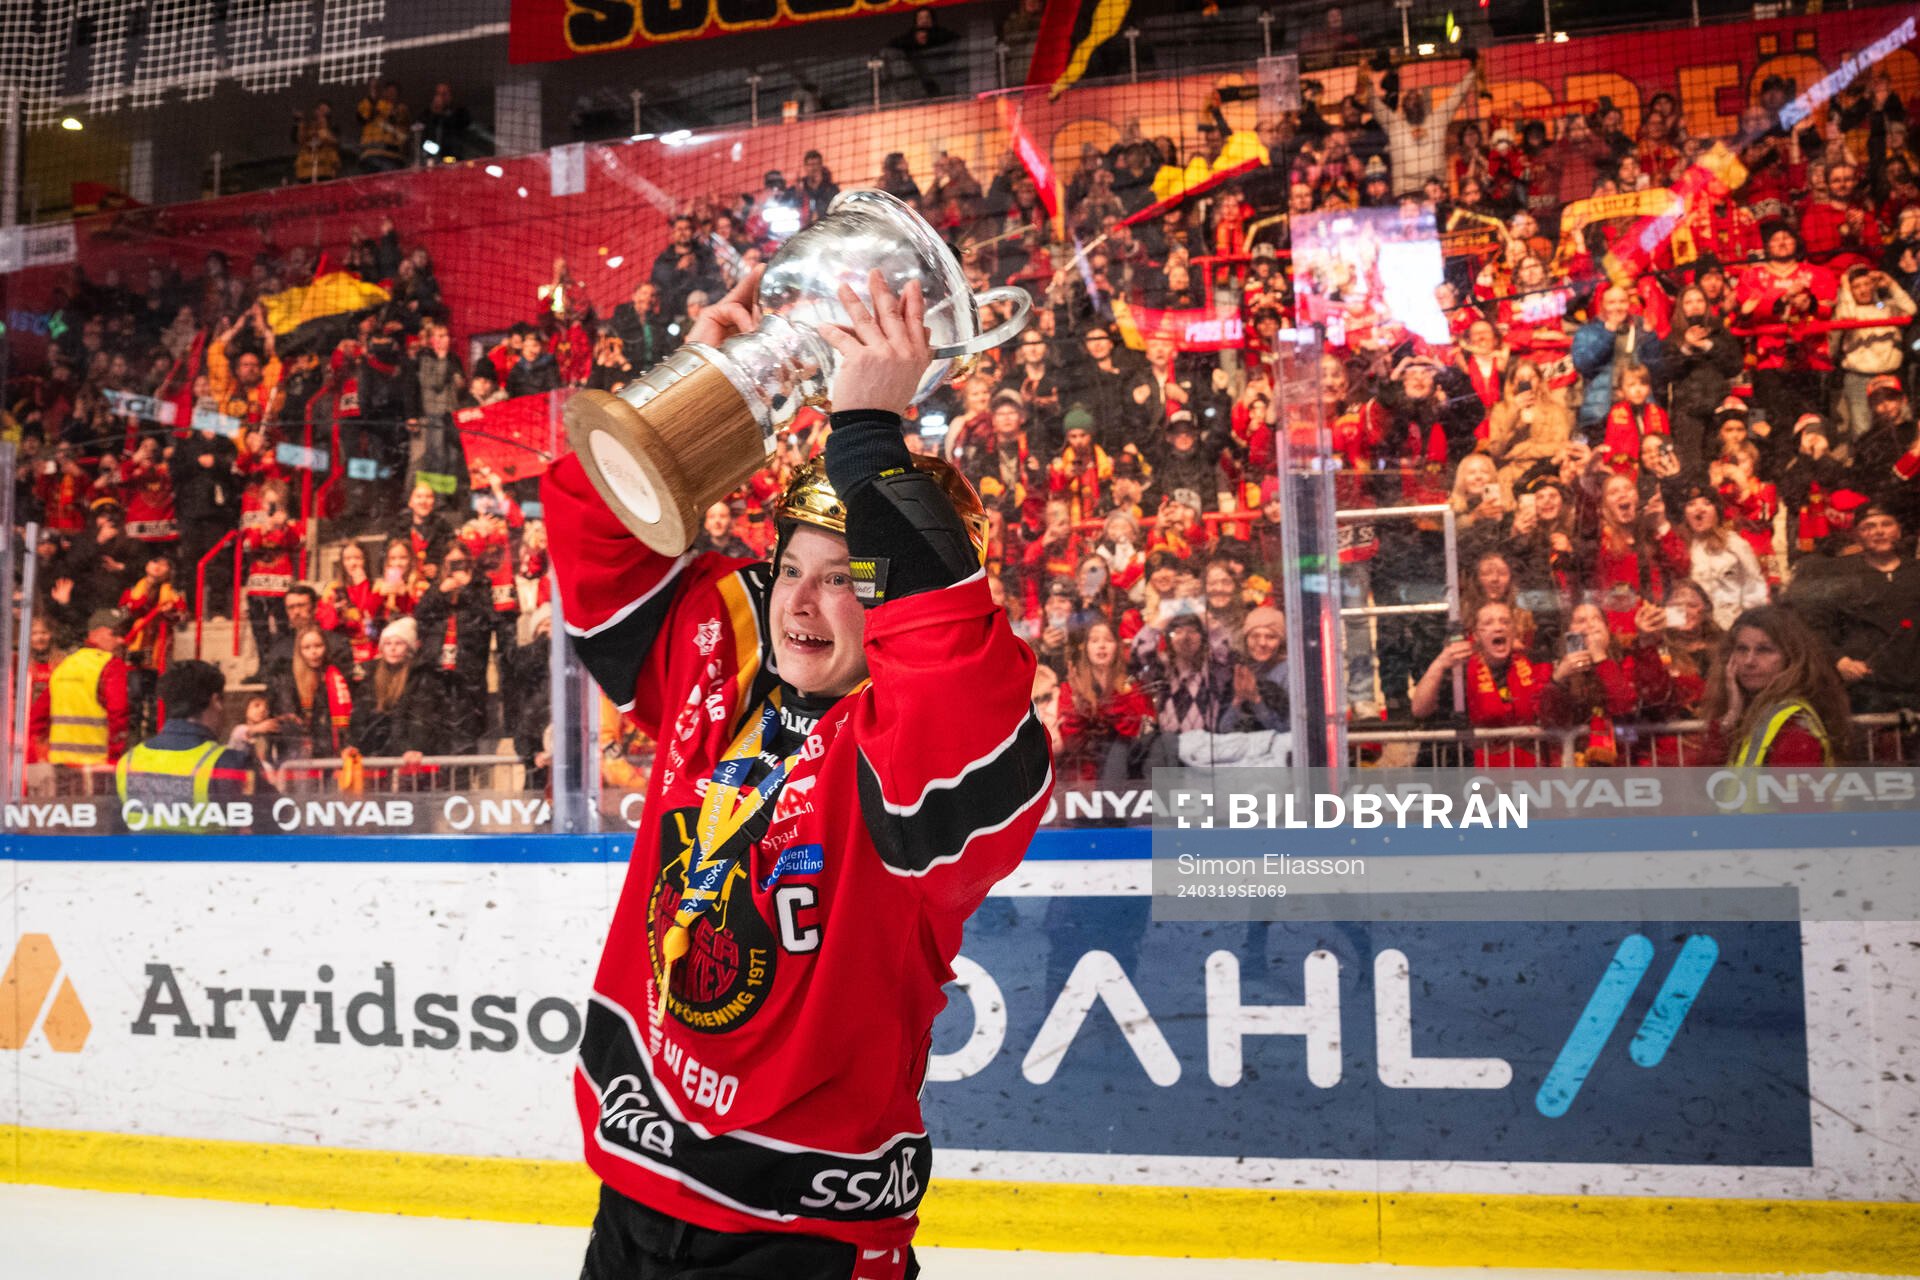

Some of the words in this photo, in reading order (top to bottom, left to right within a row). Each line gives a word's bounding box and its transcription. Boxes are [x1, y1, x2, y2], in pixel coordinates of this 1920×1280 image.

[1512, 778, 1663, 808] NYAB
[1757, 771, 1916, 801] NYAB
[5, 803, 97, 828] NYAB
[153, 802, 253, 827] NYAB
[305, 800, 414, 827] NYAB
[480, 799, 596, 826] NYA
[1065, 789, 1205, 819] NYAB
[776, 886, 819, 953] C
[747, 948, 767, 986] 1977
[800, 1146, 919, 1211] SSAB
